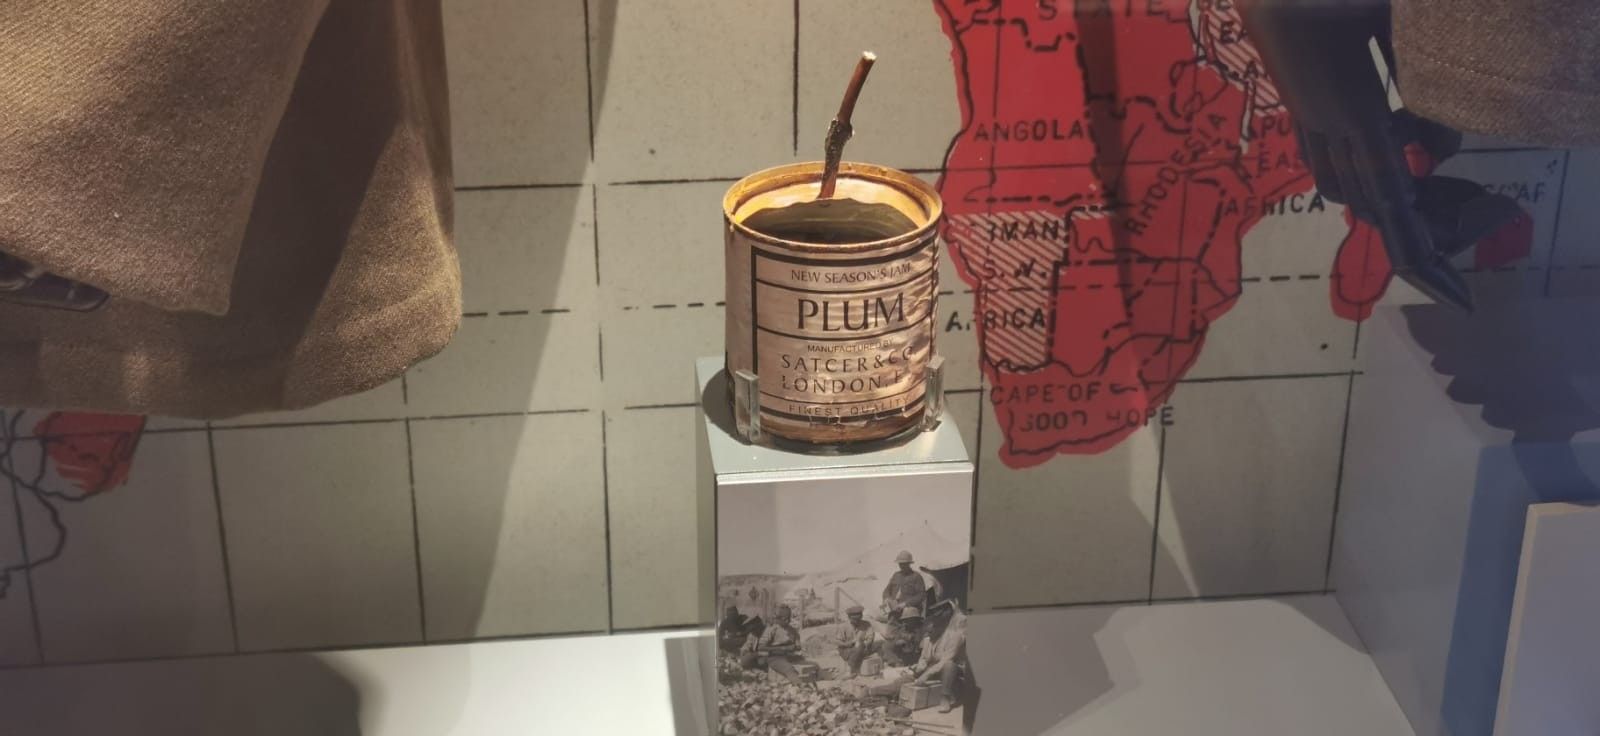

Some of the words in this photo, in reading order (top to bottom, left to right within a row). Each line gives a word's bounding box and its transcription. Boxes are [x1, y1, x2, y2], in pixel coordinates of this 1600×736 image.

[974, 118, 1084, 142] ANGOLA
[1225, 193, 1326, 217] AFRICA
[791, 269, 820, 283] NEW
[824, 267, 887, 284] SEASON'S
[797, 292, 905, 332] PLUM
[788, 404, 841, 416] FINEST
[850, 394, 910, 415] QUALITY
[990, 384, 1054, 405] CAPE
[1067, 382, 1101, 402] OF
